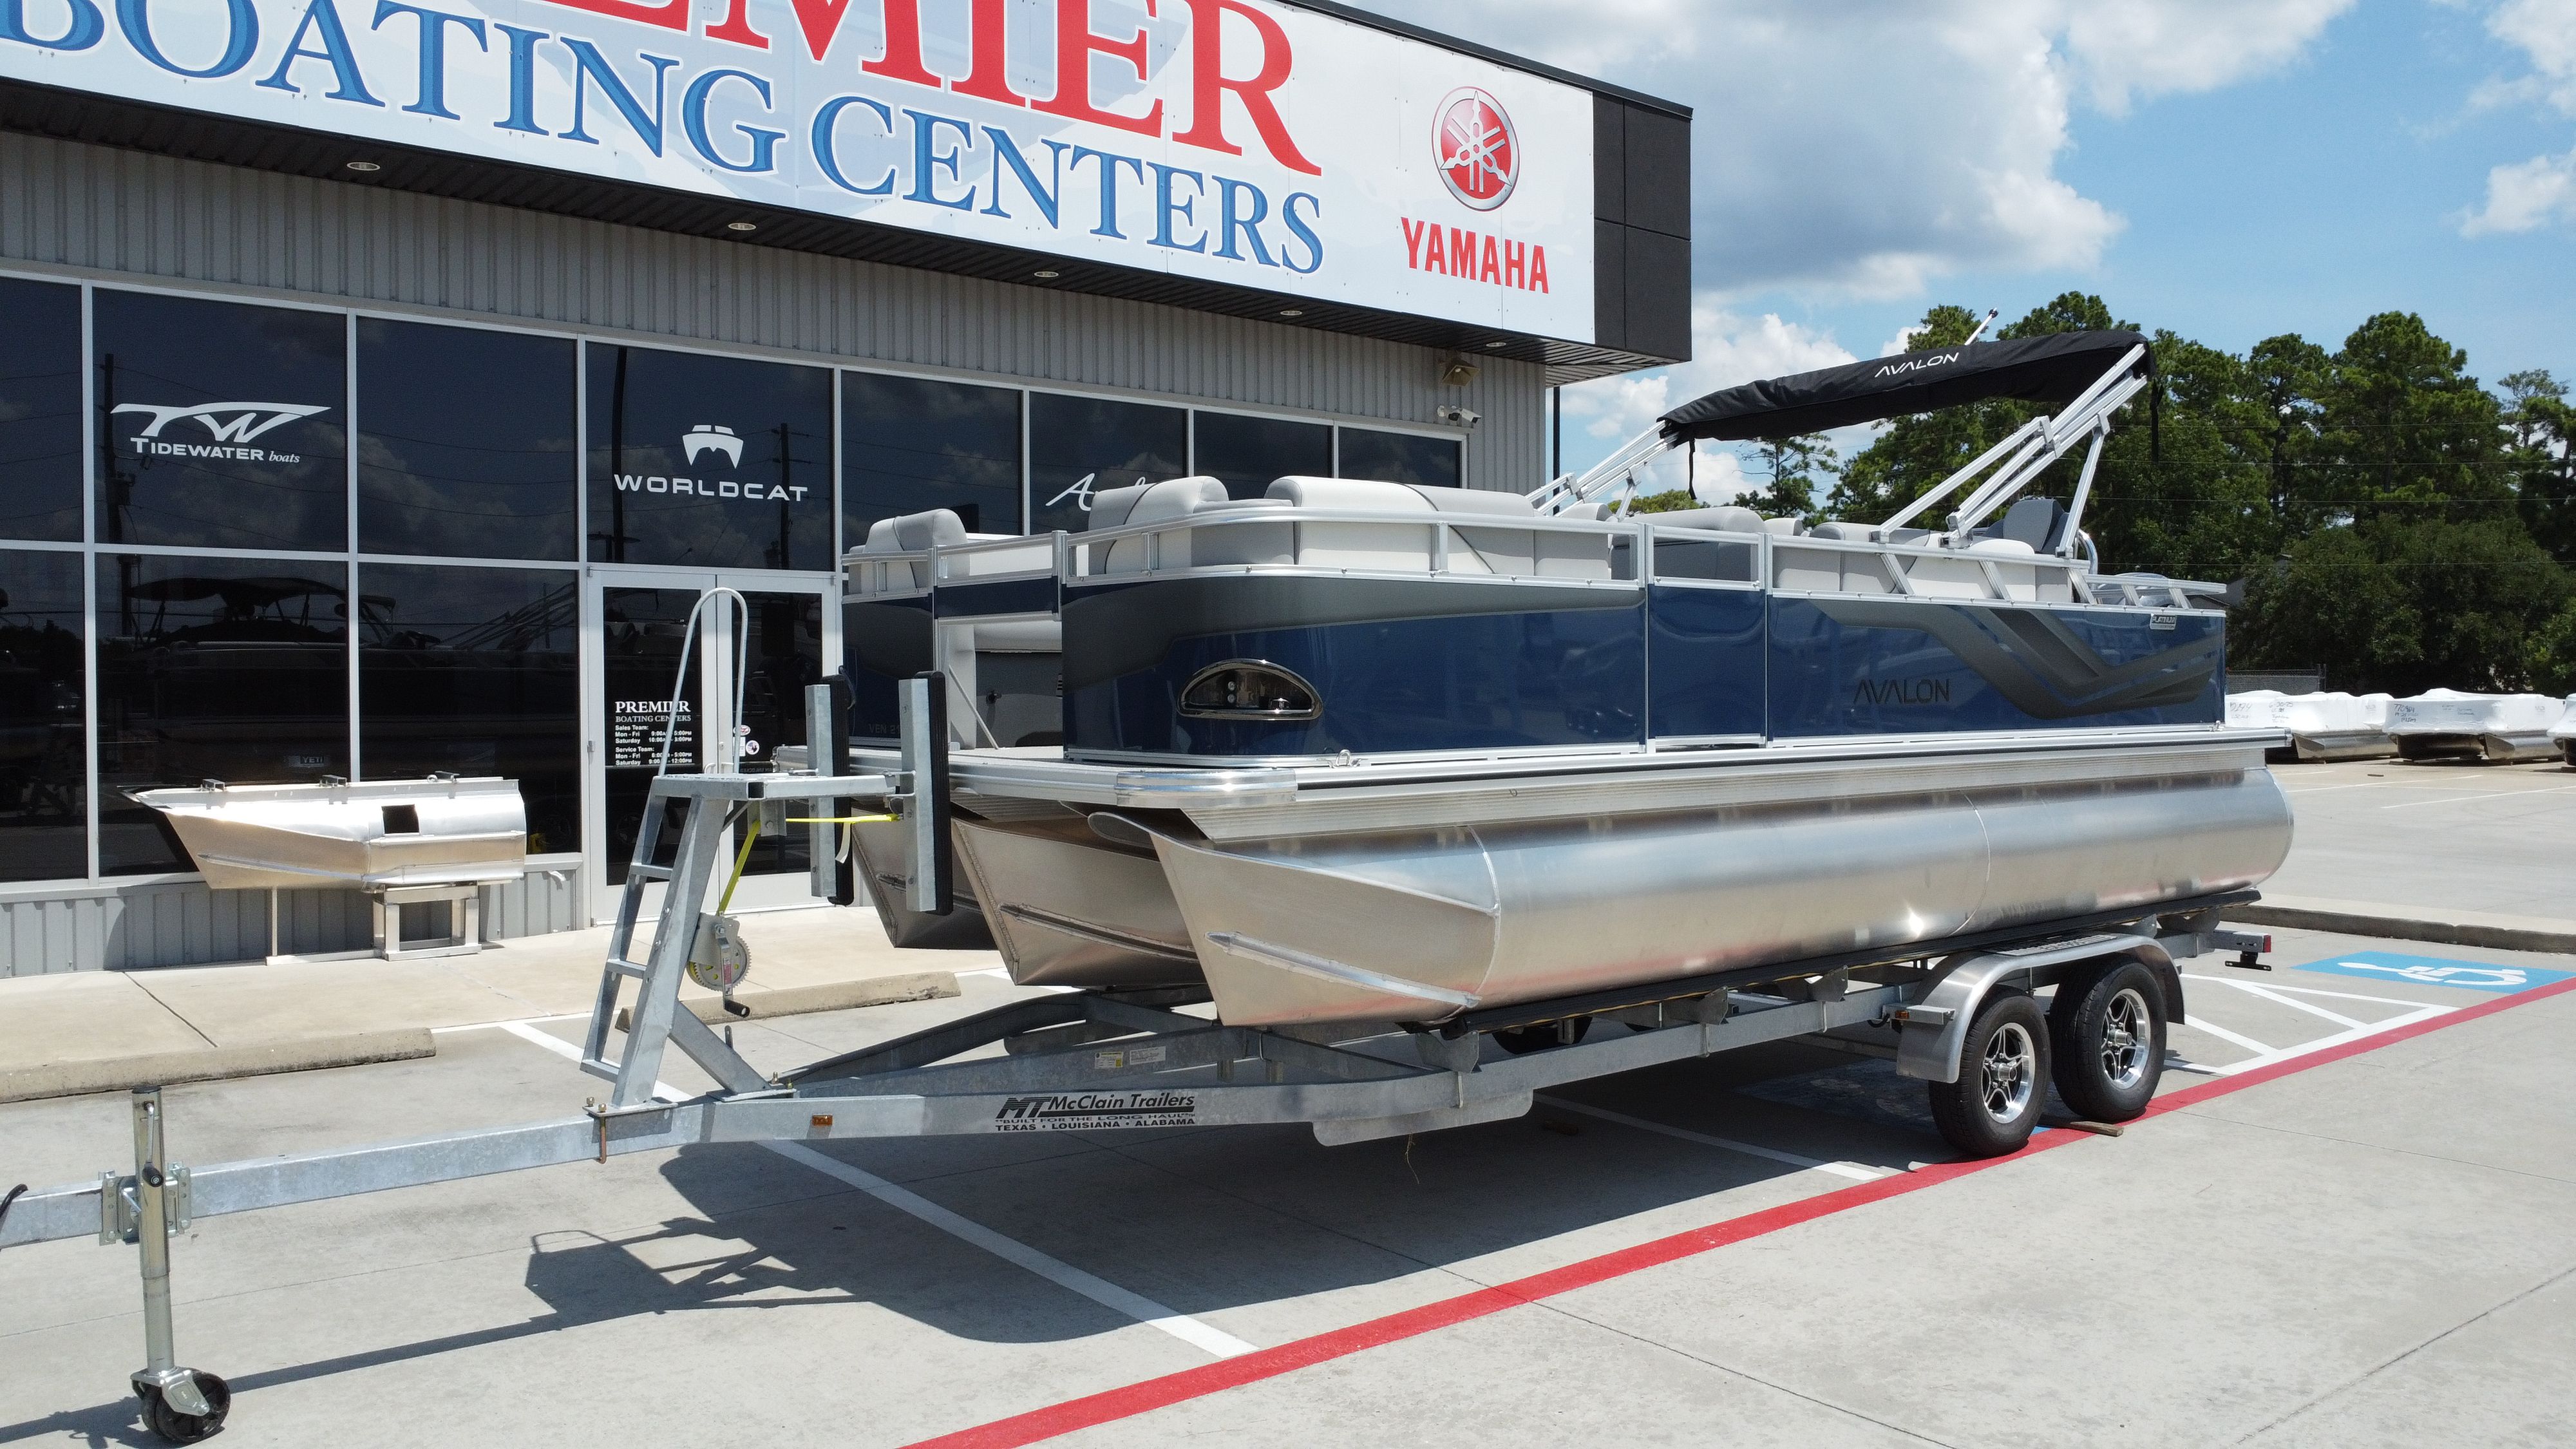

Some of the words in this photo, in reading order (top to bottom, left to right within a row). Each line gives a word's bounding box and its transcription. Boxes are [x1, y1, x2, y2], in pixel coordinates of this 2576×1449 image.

[813, 96, 1325, 274] CENTERS
[1401, 217, 1549, 294] YAMAHA
[1875, 352, 1959, 378] AVALON
[131, 437, 264, 460] TIDEWATER
[269, 451, 300, 464] boats
[614, 474, 808, 502] WORLDCAT
[1853, 679, 1950, 704] AVALON
[996, 1096, 1052, 1119] MT
[1048, 1094, 1124, 1110] McClain
[1130, 1093, 1195, 1108] Trailers
[1052, 1121, 1120, 1130] LOUISIANA
